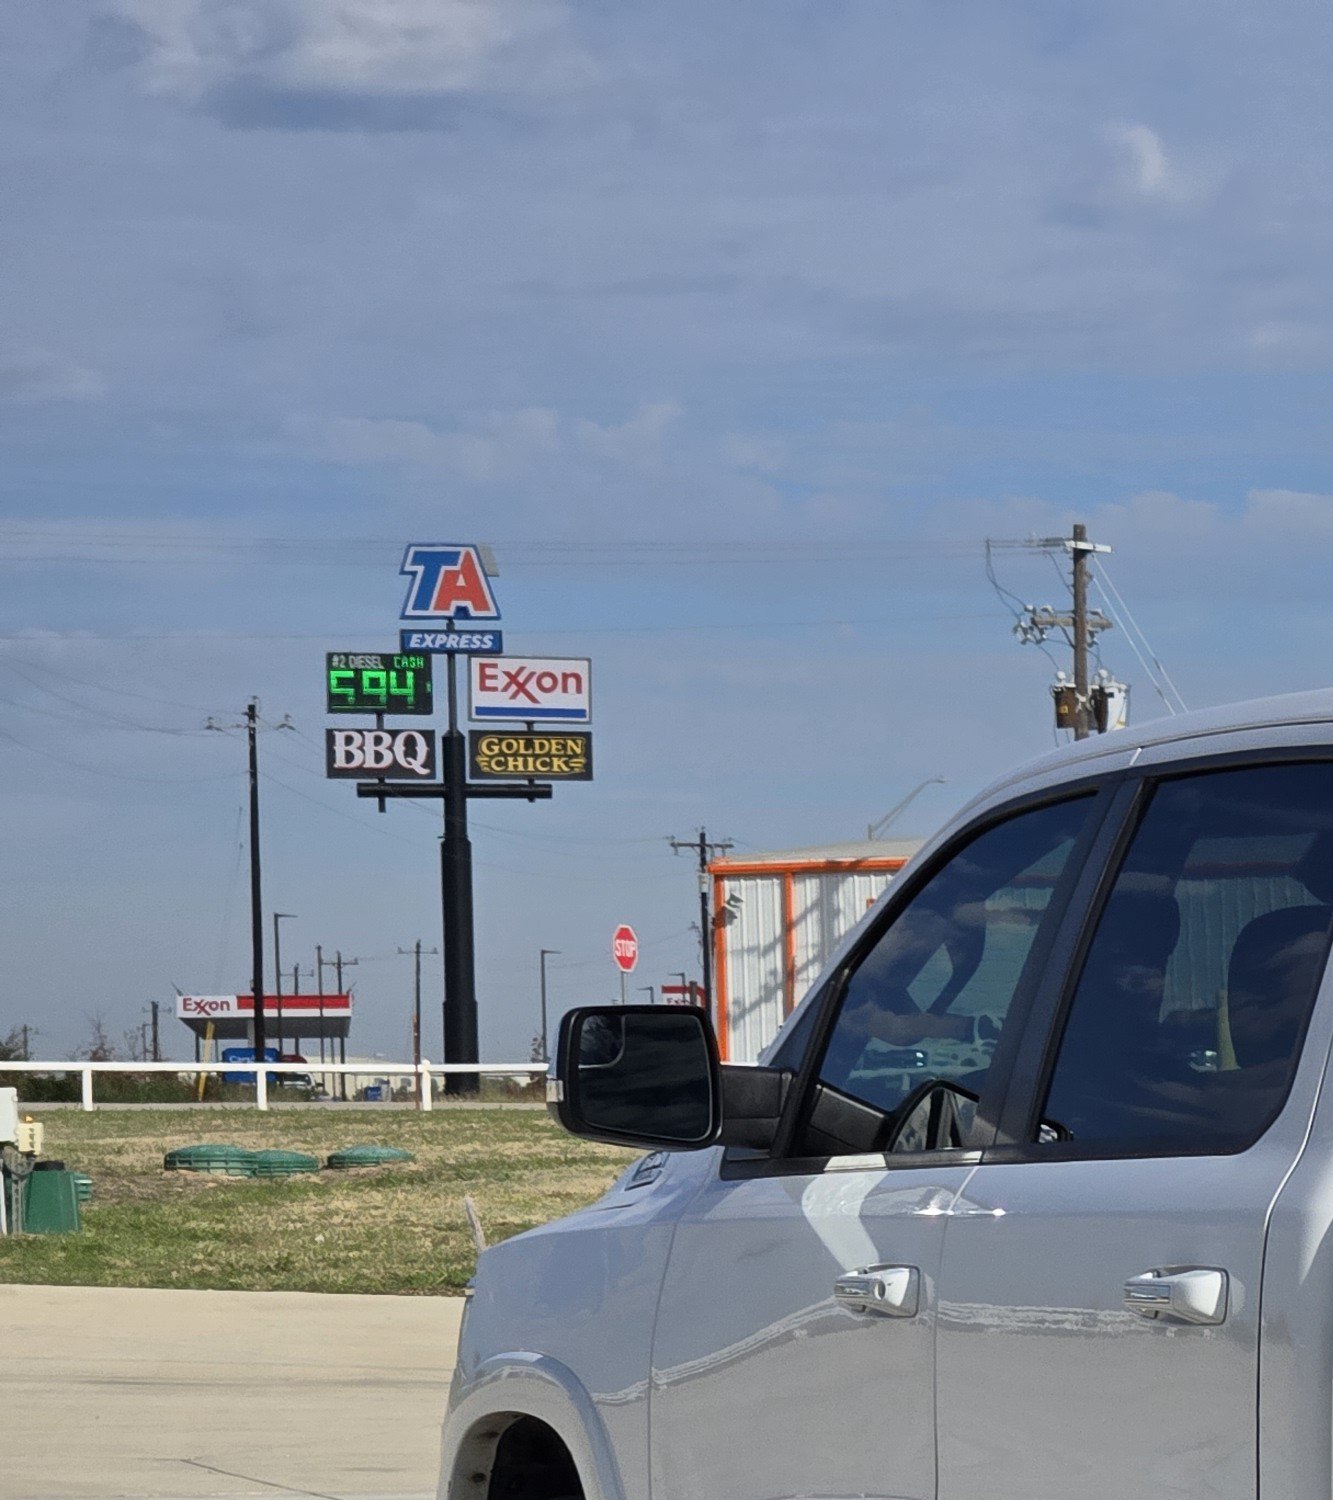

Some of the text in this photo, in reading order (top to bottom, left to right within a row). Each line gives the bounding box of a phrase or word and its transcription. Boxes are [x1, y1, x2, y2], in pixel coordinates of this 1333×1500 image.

[409, 549, 492, 612] TA
[410, 634, 494, 649] EXPRESS
[393, 656, 424, 669] CASH
[479, 662, 583, 704] Exxon
[333, 731, 431, 775] BBQ
[480, 737, 583, 756] GOLDEN
[491, 756, 571, 772] CHICK
[615, 940, 636, 957] STOP
[182, 998, 230, 1015] Exxon
